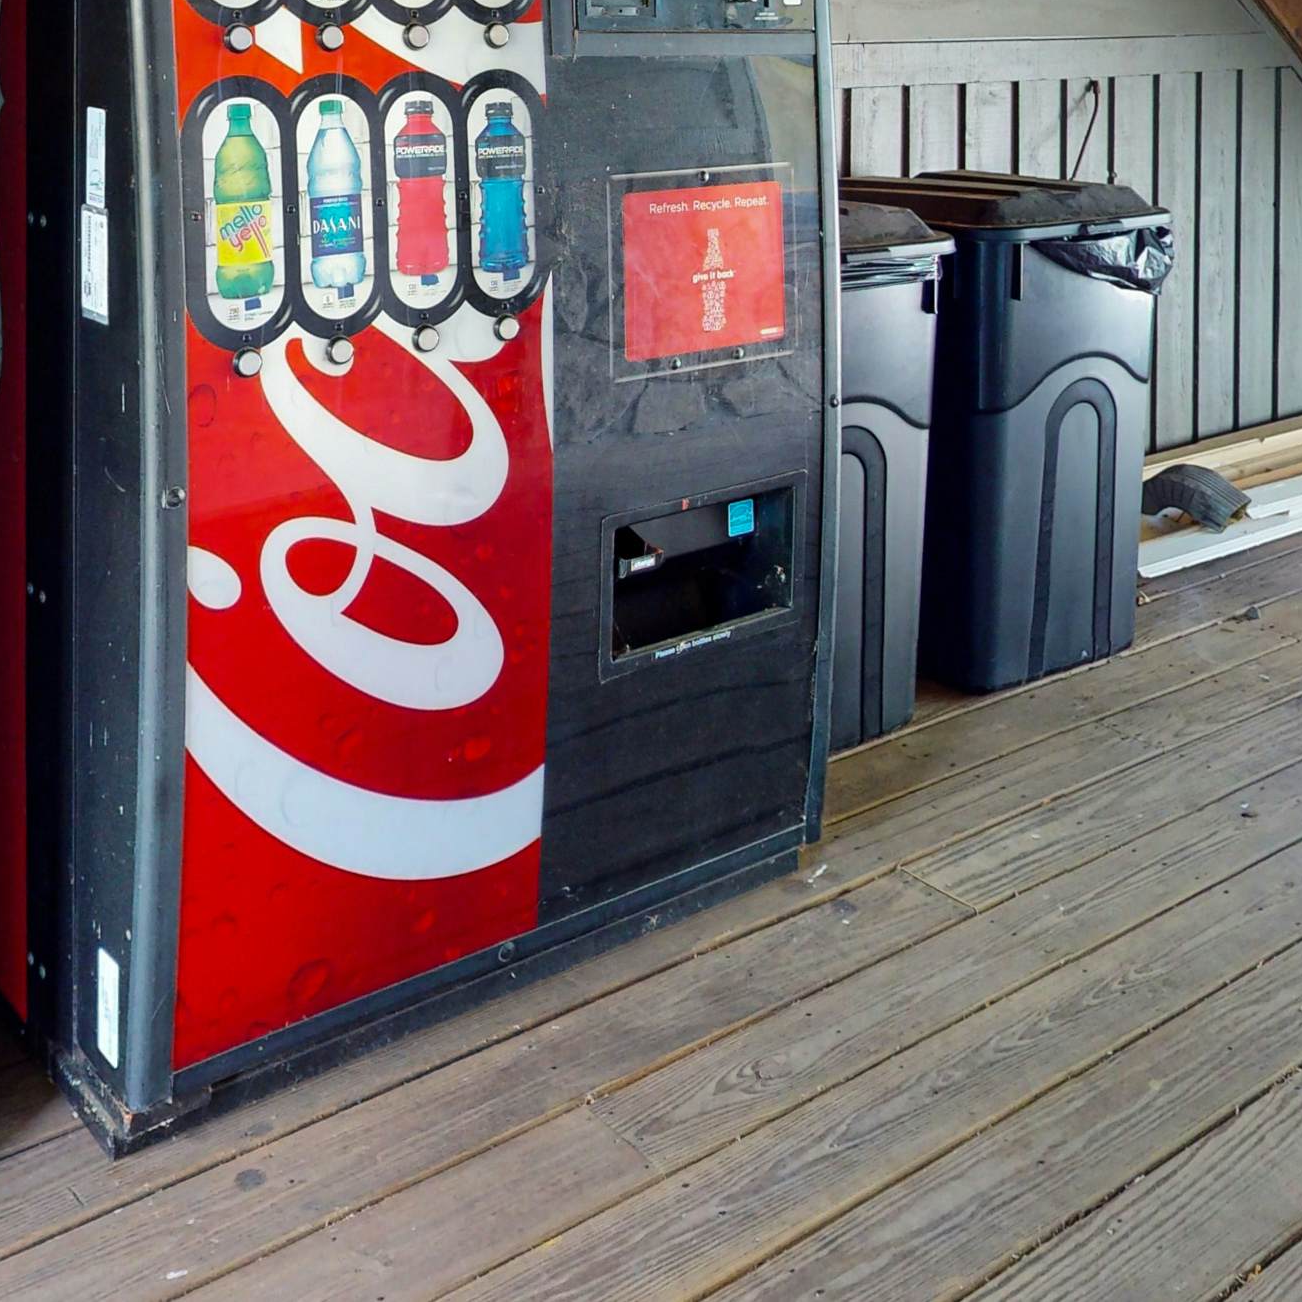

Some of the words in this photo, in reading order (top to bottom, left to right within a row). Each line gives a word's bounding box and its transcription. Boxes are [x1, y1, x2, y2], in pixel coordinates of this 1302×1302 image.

[395, 144, 446, 156] POWERADE
[477, 144, 524, 157] POWERADE
[219, 203, 263, 241] mello
[312, 215, 361, 235] DASANI
[229, 215, 271, 259] yello
